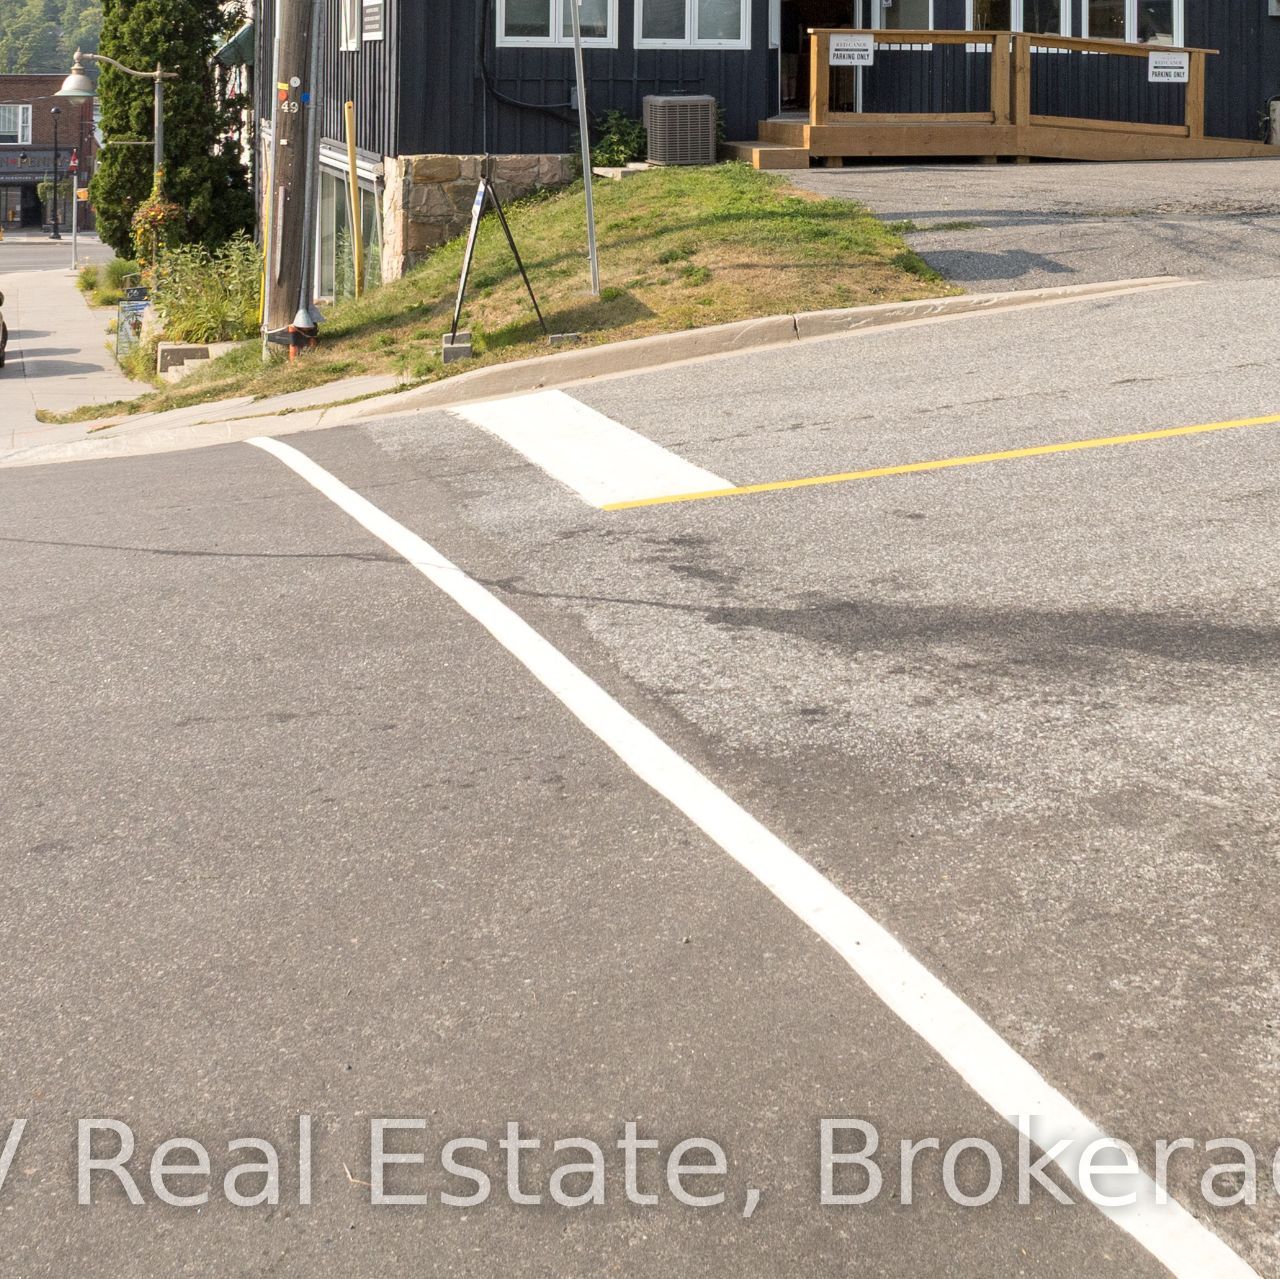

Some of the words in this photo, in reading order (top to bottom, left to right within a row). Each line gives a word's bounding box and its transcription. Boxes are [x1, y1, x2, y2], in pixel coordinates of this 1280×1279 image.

[832, 52, 855, 60] PARKING
[856, 53, 869, 61] ONLY
[1151, 70, 1172, 78] PARKING
[1173, 70, 1185, 78] ONLY
[281, 100, 299, 114] 49
